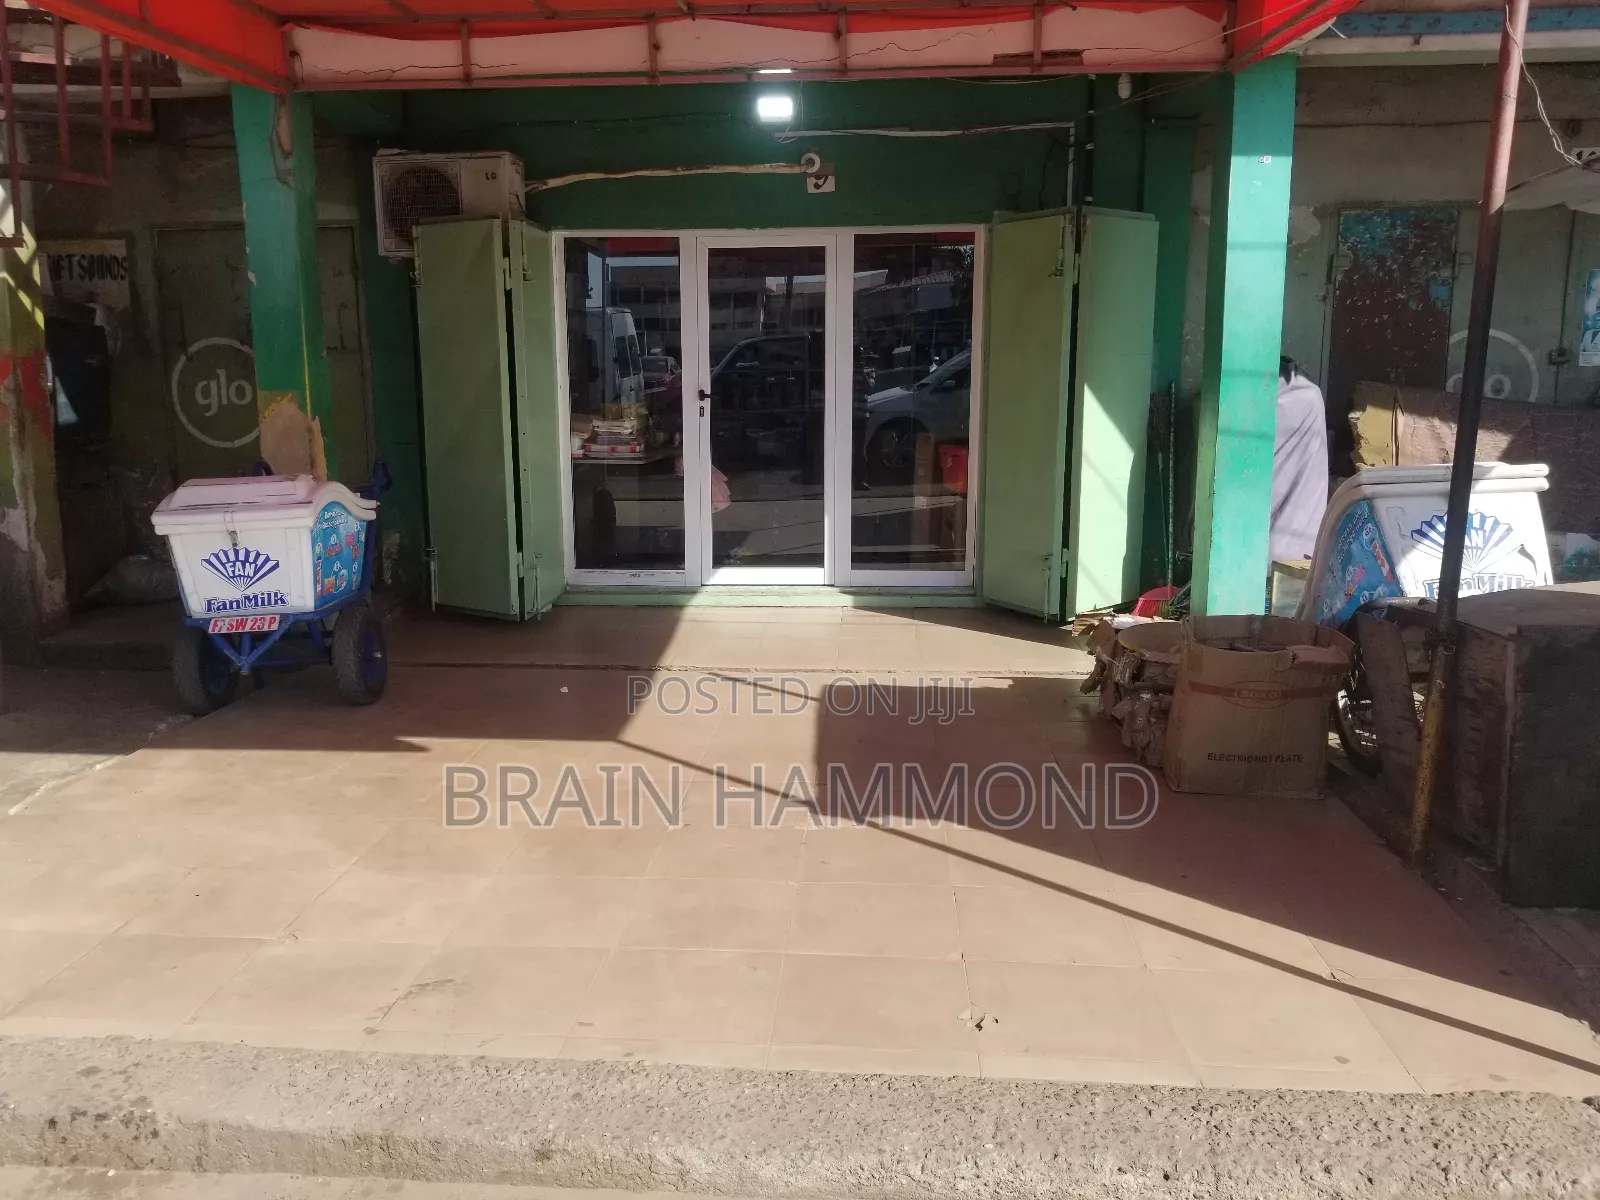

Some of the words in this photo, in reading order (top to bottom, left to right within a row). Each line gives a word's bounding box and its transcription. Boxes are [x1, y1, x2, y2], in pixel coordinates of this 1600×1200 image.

[485, 172, 497, 180] LG
[195, 368, 252, 416] glo
[225, 561, 256, 577] FAN
[204, 590, 289, 614] FanMilk
[249, 616, 266, 630] 23
[267, 616, 277, 629] P
[1207, 752, 1254, 763] ELECTRIC
[1255, 755, 1273, 763] HOT
[1274, 754, 1304, 763] PLATE
